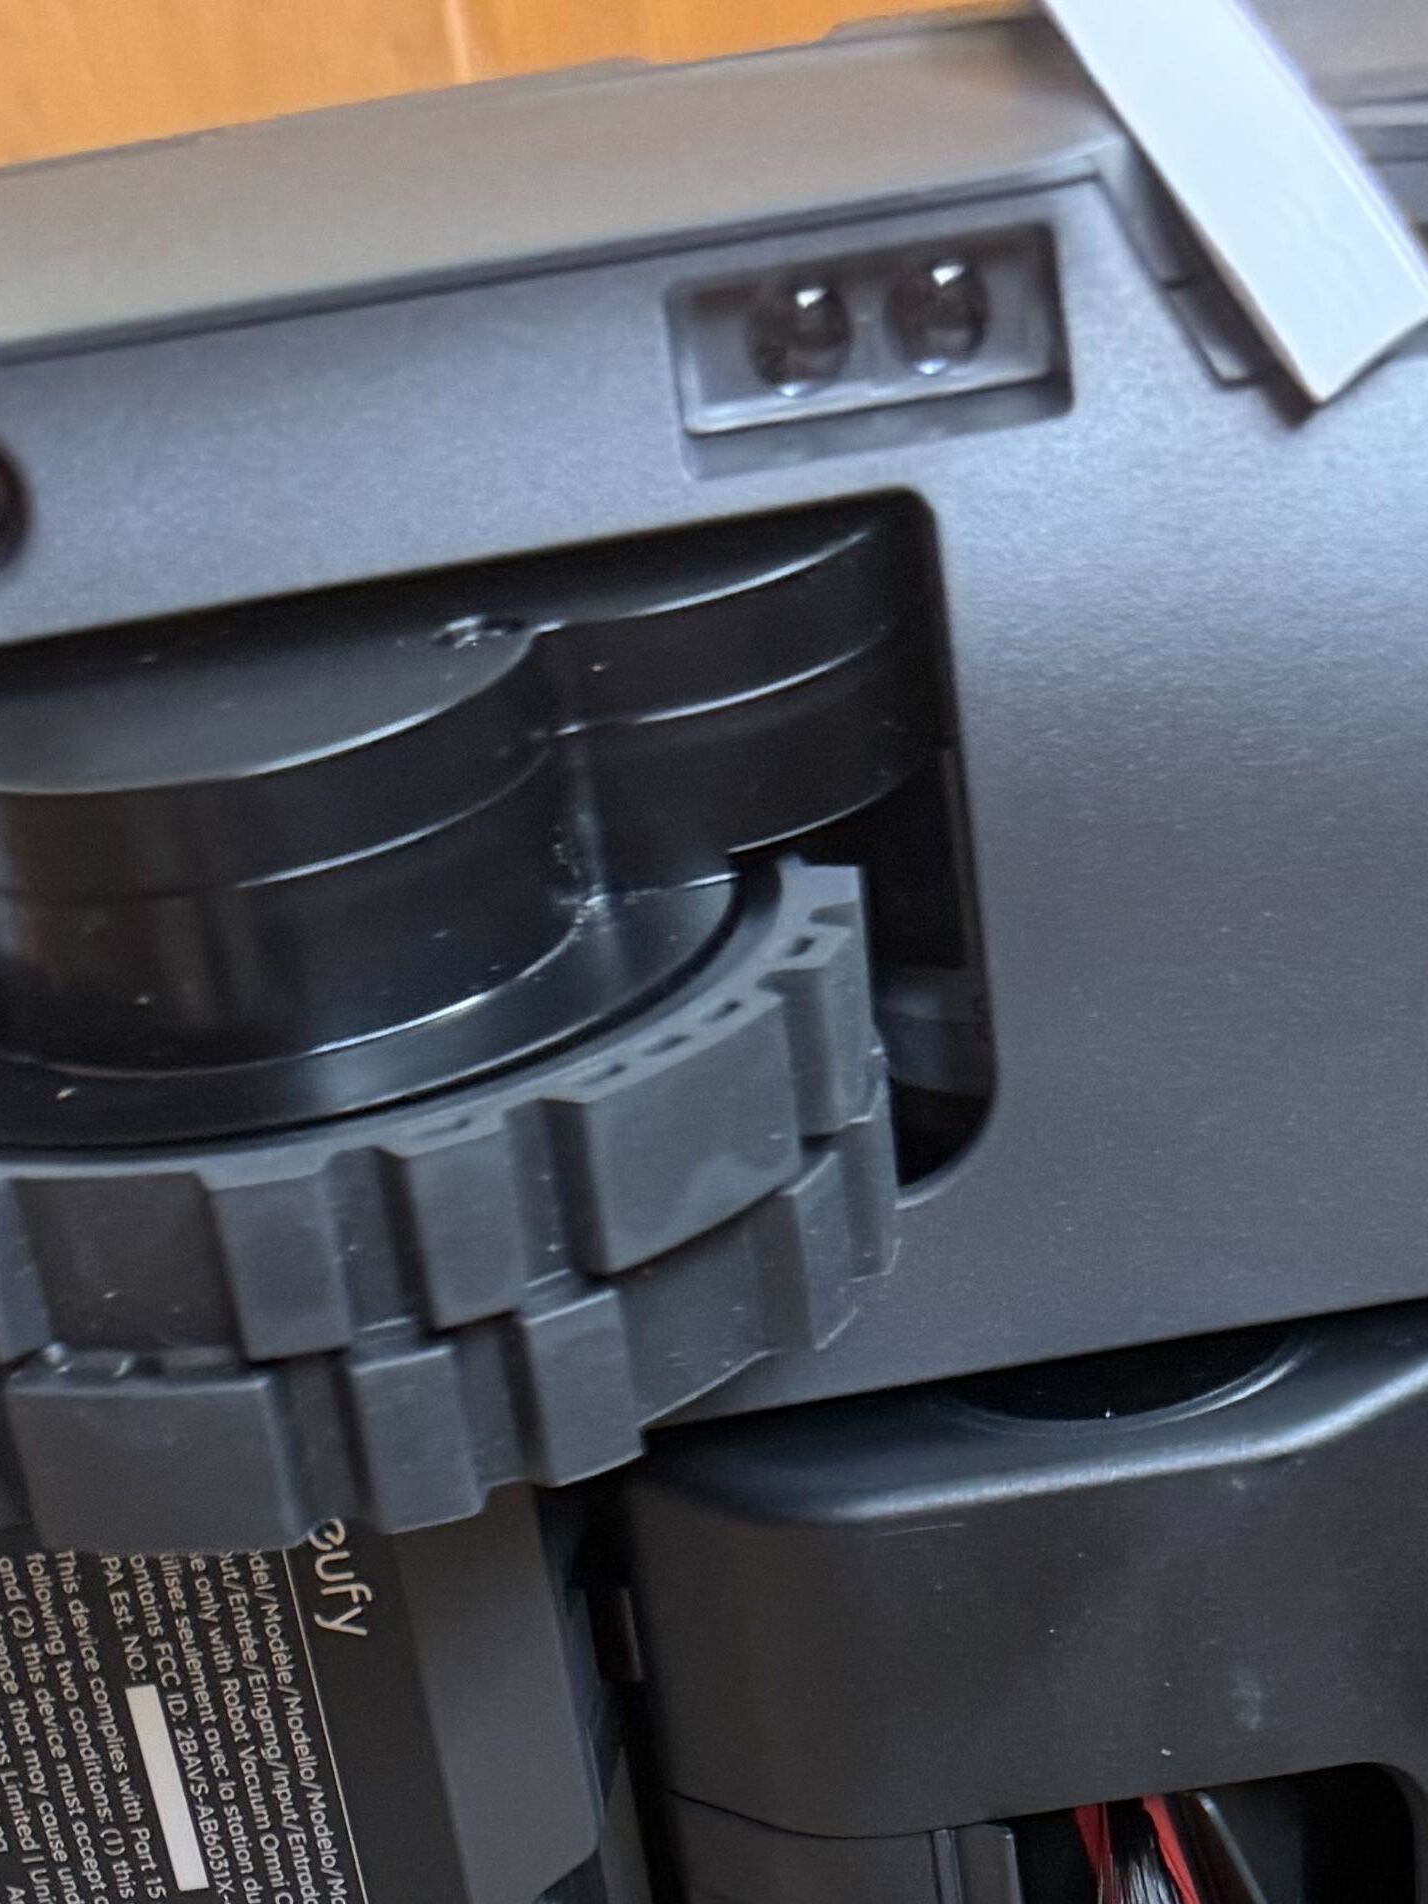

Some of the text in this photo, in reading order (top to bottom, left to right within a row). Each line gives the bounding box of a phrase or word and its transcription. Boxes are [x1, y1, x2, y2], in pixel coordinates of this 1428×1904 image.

[54, 1548, 80, 1594] This
[301, 1517, 370, 1640] eufy
[108, 1589, 134, 1630] Est.
[193, 1575, 221, 1622] only
[66, 1597, 101, 1672] device
[120, 1633, 148, 1681] NO.:
[207, 1625, 235, 1674] with
[173, 1614, 218, 1725] seulement
[7, 1697, 37, 1746] that
[88, 1675, 129, 1774] complies
[219, 1676, 252, 1743] Robot
[21, 1747, 49, 1797] may
[202, 1726, 230, 1778] avec
[116, 1775, 144, 1823] with
[216, 1779, 237, 1801] la
[236, 1743, 272, 1831] Vacuum
[36, 1799, 69, 1863] cause
[129, 1825, 158, 1872] Part
[221, 1803, 255, 1875] station
[258, 1831, 291, 1889] Omni
[143, 1874, 168, 1900] 15
[240, 1875, 264, 1904] du
